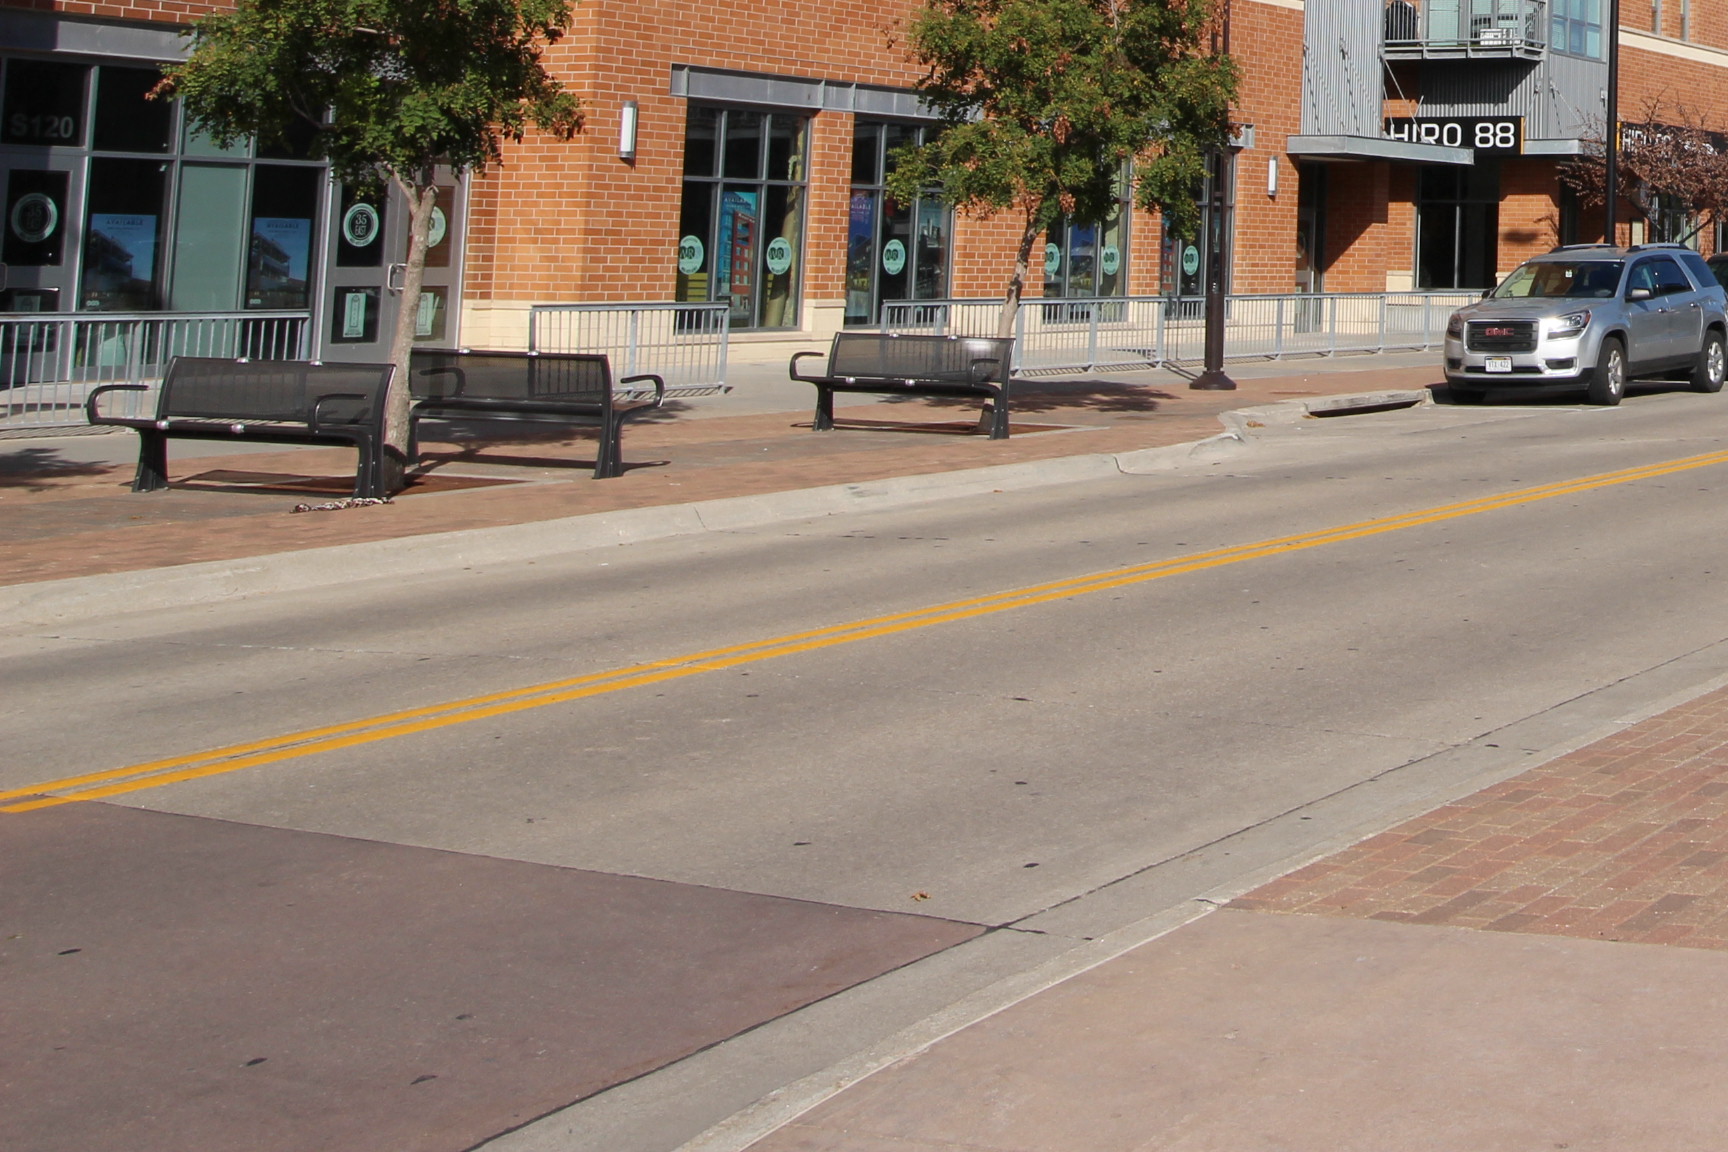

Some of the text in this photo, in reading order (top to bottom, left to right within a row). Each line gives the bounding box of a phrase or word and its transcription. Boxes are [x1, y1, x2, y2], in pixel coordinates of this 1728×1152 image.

[10, 114, 74, 138] S120
[1391, 122, 1515, 148] HIRO 88
[355, 214, 367, 225] 35
[1485, 328, 1515, 336] GMC
